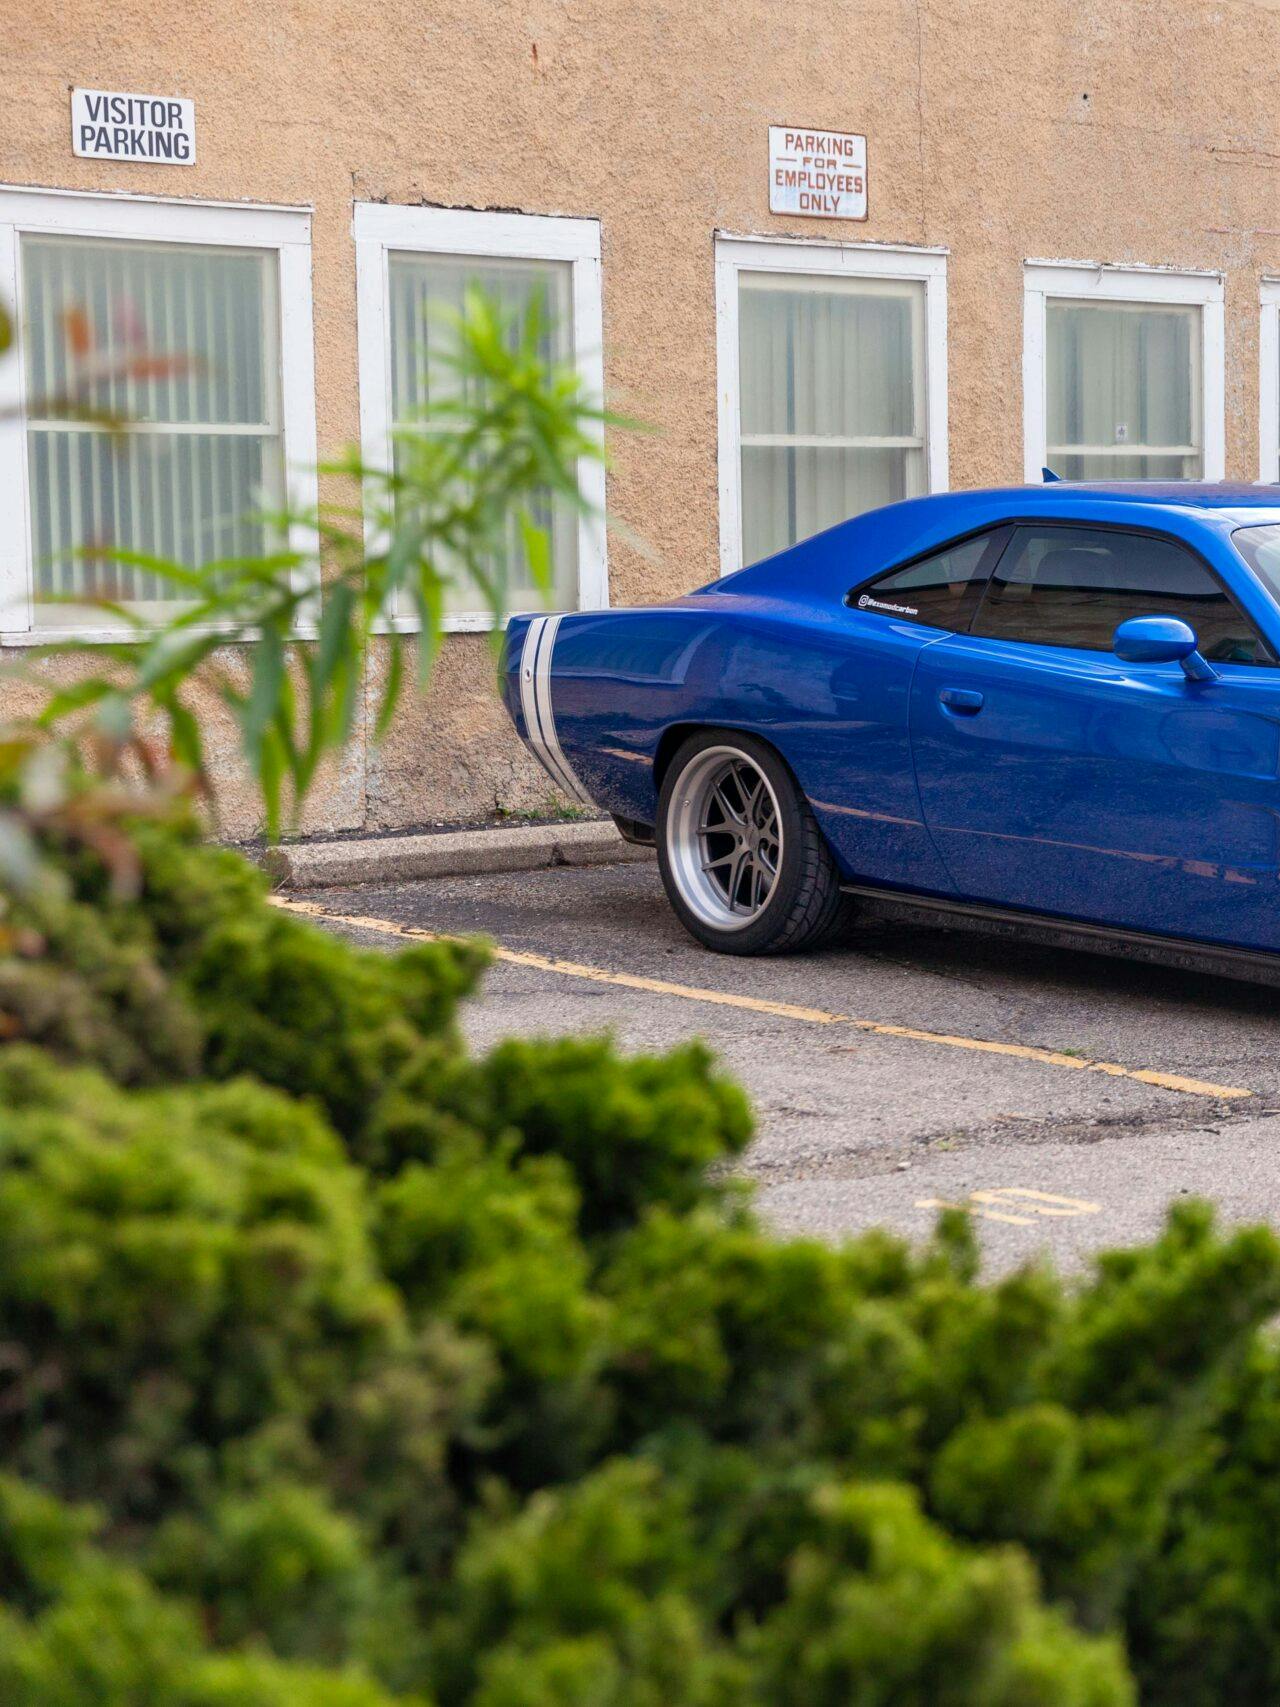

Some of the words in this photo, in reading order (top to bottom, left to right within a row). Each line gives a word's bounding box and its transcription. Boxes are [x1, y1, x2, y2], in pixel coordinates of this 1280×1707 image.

[84, 95, 183, 129] VISITOR
[80, 125, 190, 160] PARKING
[785, 133, 853, 157] PARKING
[802, 156, 838, 170] FOR
[775, 168, 863, 194] EMPLOYEES
[799, 193, 841, 212] ONLY
